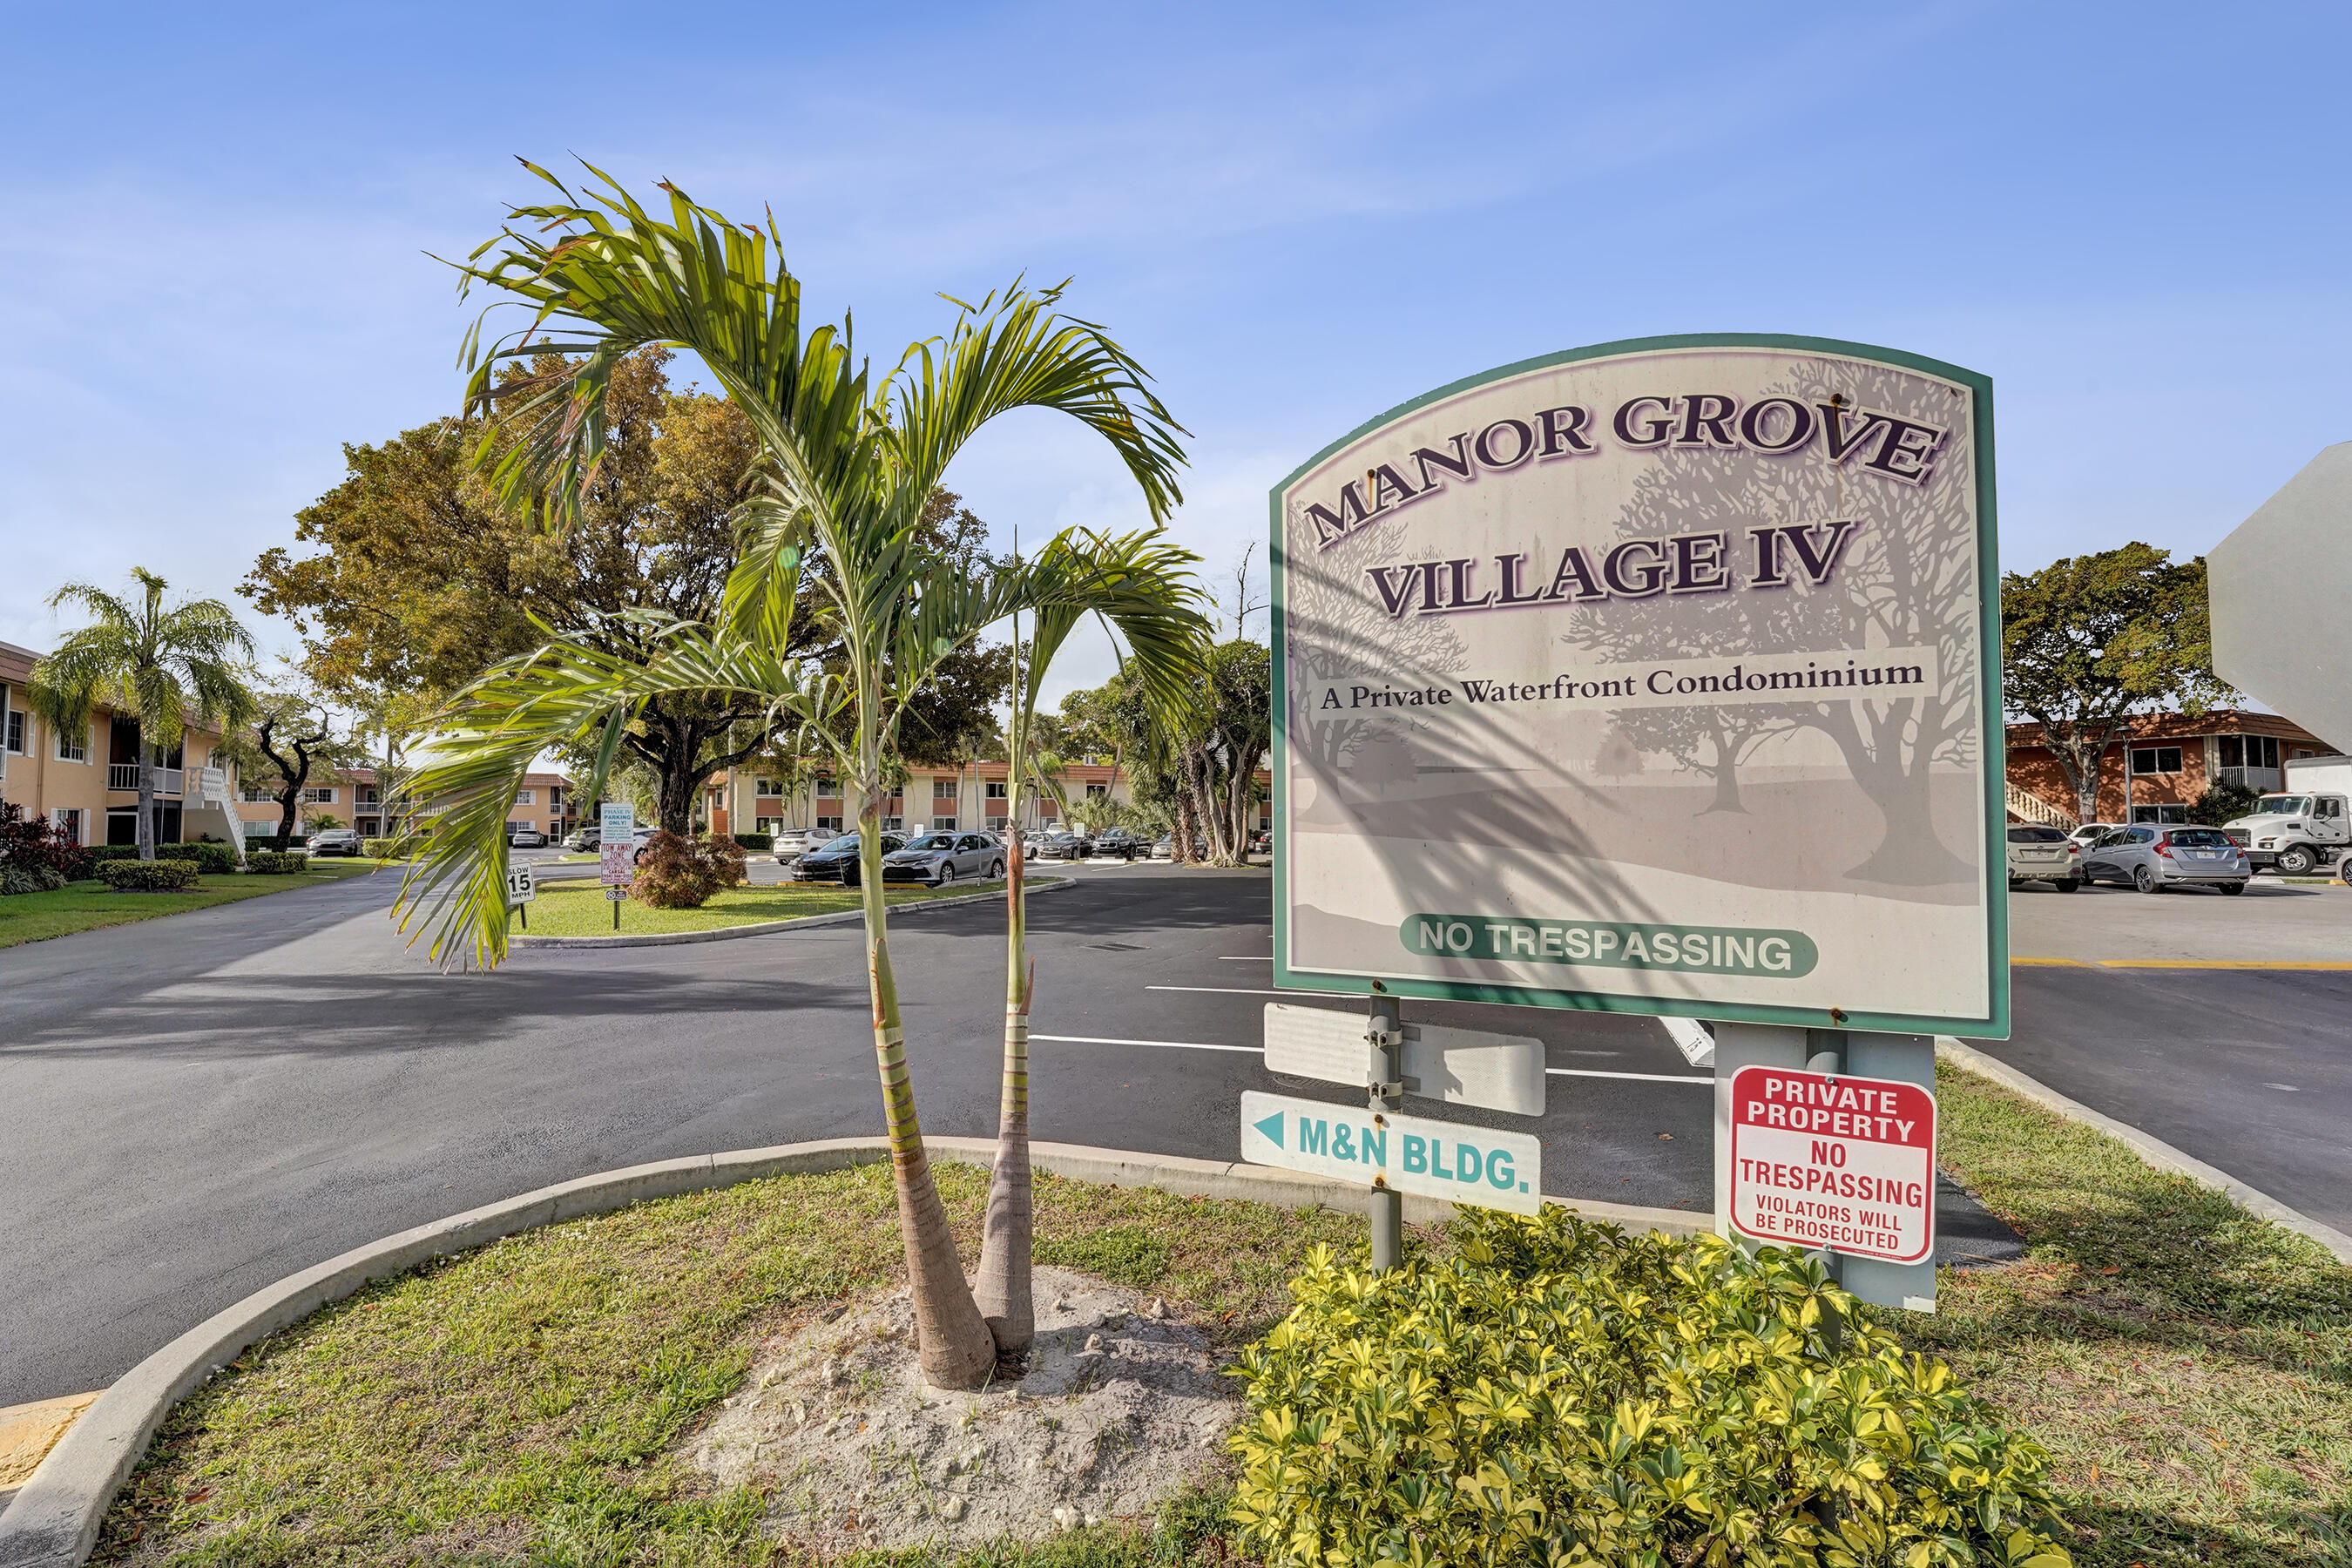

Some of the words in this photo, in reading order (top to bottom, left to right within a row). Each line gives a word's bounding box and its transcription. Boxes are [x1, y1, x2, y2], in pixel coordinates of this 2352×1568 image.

[1304, 405, 1593, 549] MANOR
[1612, 393, 1944, 482] GROVE
[1365, 534, 1726, 615] VILLAGE
[1748, 521, 1853, 584] IV
[1320, 686, 1342, 710] A
[1350, 684, 1452, 708] Private
[1460, 673, 1636, 704] Waterfront
[1646, 660, 1924, 694] Condominium
[603, 843, 614, 852] TOW
[617, 843, 632, 852] AWAY
[610, 851, 625, 860] ZONE
[508, 867, 529, 875] SLOW
[508, 874, 531, 893] 15
[1418, 920, 1474, 952] NO
[1484, 923, 1792, 971] TRESPASSING
[1765, 1077, 1898, 1115] PRIVATE
[1747, 1100, 1916, 1143] PROPERTY
[1299, 1116, 1387, 1167] M&N
[1402, 1133, 1529, 1194] BLDG.
[1811, 1139, 1847, 1168] NO
[1740, 1158, 1923, 1208] TRESPASSING
[1755, 1213, 1776, 1231] BE
[1784, 1217, 1899, 1250] PROSECUTED
[1756, 1193, 1851, 1223] VIOLATORS
[1859, 1210, 1903, 1232] WILL
